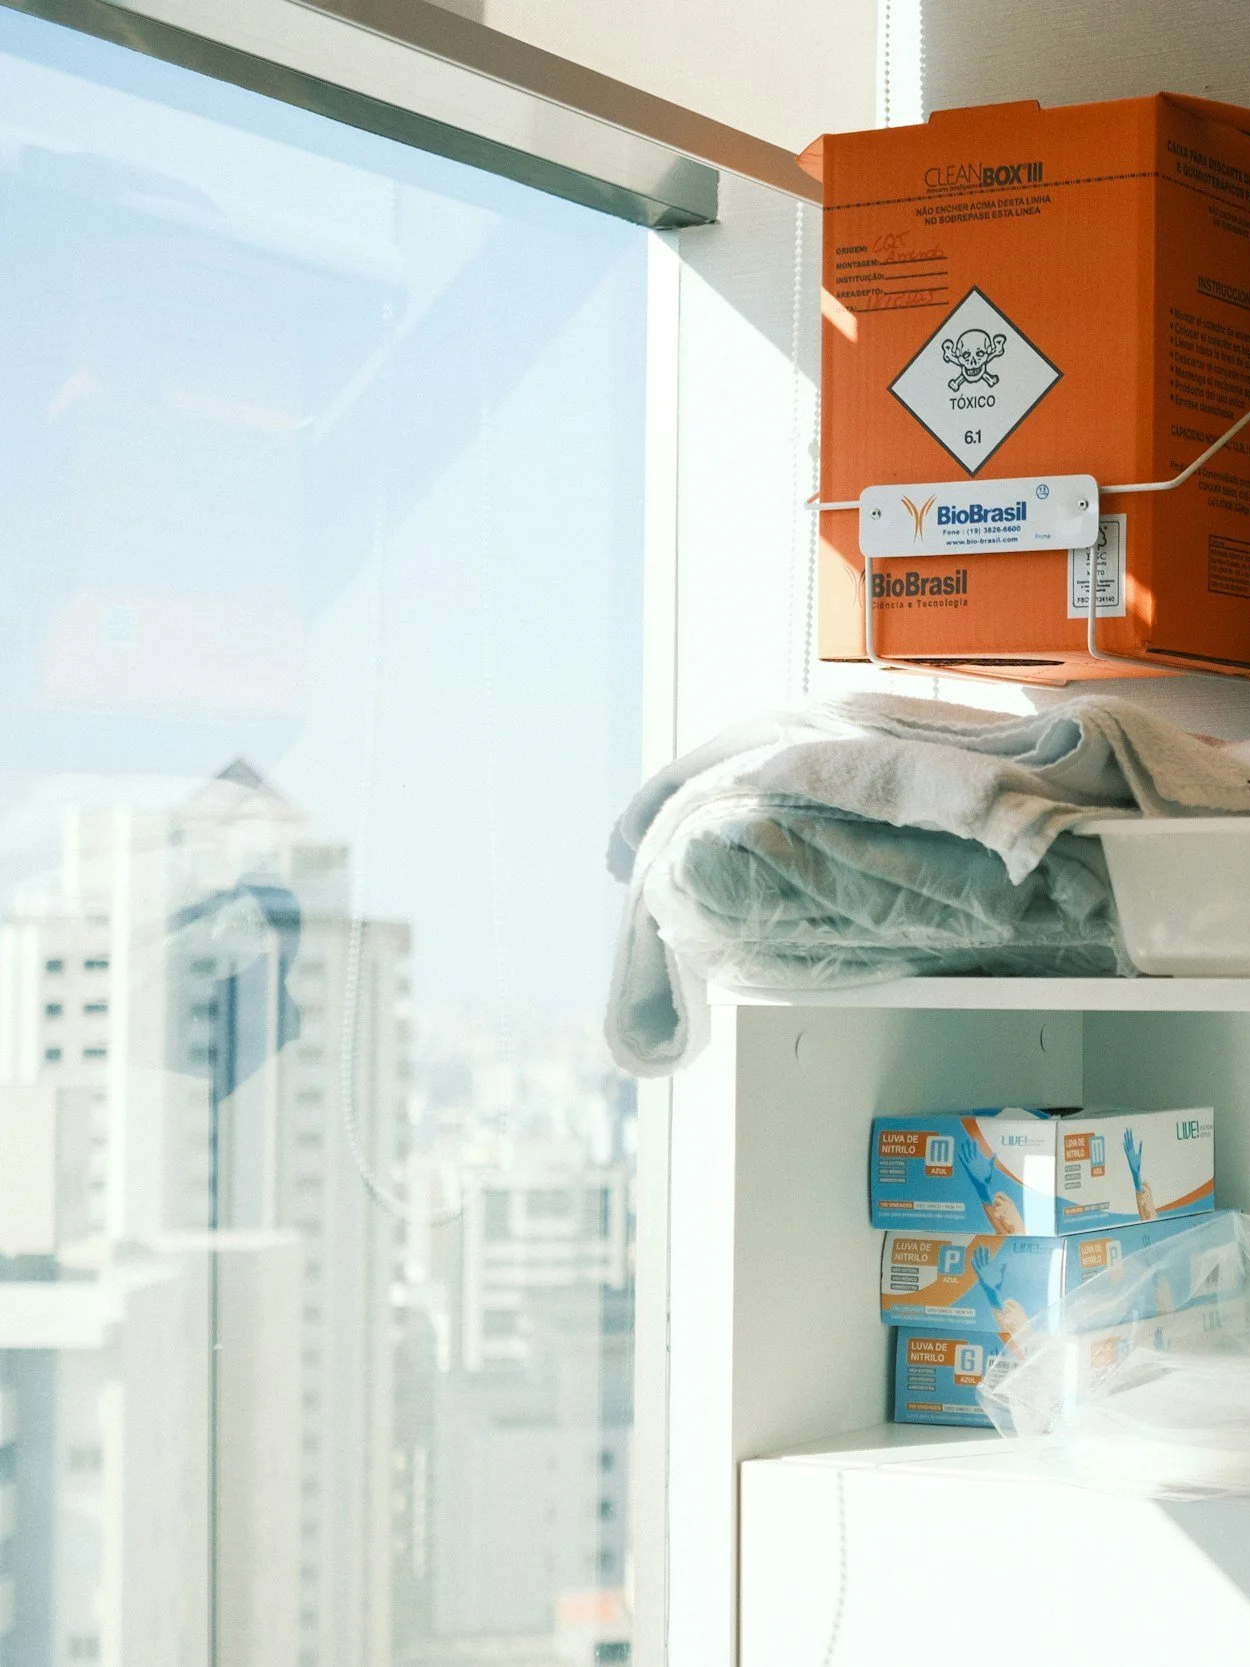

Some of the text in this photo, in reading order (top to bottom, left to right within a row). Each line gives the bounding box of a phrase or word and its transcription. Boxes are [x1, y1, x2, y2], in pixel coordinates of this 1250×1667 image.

[1167, 139, 1187, 156] CAIXA
[1189, 150, 1207, 165] PARA
[1209, 158, 1242, 183] DESCARTE
[916, 194, 1051, 216] NÃO ENCHER ACIMA DESTA LINHA
[924, 217, 937, 226] NO
[938, 212, 990, 225] SOBREPASE
[992, 209, 1013, 220] ESTA
[836, 245, 868, 255] ORIGEM:
[836, 259, 880, 270] MONTAGEM:
[836, 273, 886, 285] INSTITUIÇÃO:
[949, 393, 996, 410] TÓXICO
[964, 429, 982, 445] 6.1
[937, 501, 1027, 525] BioBrasil
[966, 527, 981, 536] (19)
[946, 536, 1018, 546] www.bio-brasil.com
[871, 569, 968, 598] BioBrasil
[917, 597, 968, 609] Tecnologia
[882, 1134, 919, 1143] LUVA DE
[881, 1145, 916, 1154] NITRILO
[931, 1167, 947, 1175] AZUL
[896, 1243, 932, 1252] LUVA DE
[894, 1253, 928, 1262] NITRILO
[944, 1250, 960, 1273] P
[935, 1343, 948, 1351] DE
[911, 1353, 945, 1362] NITRILO
